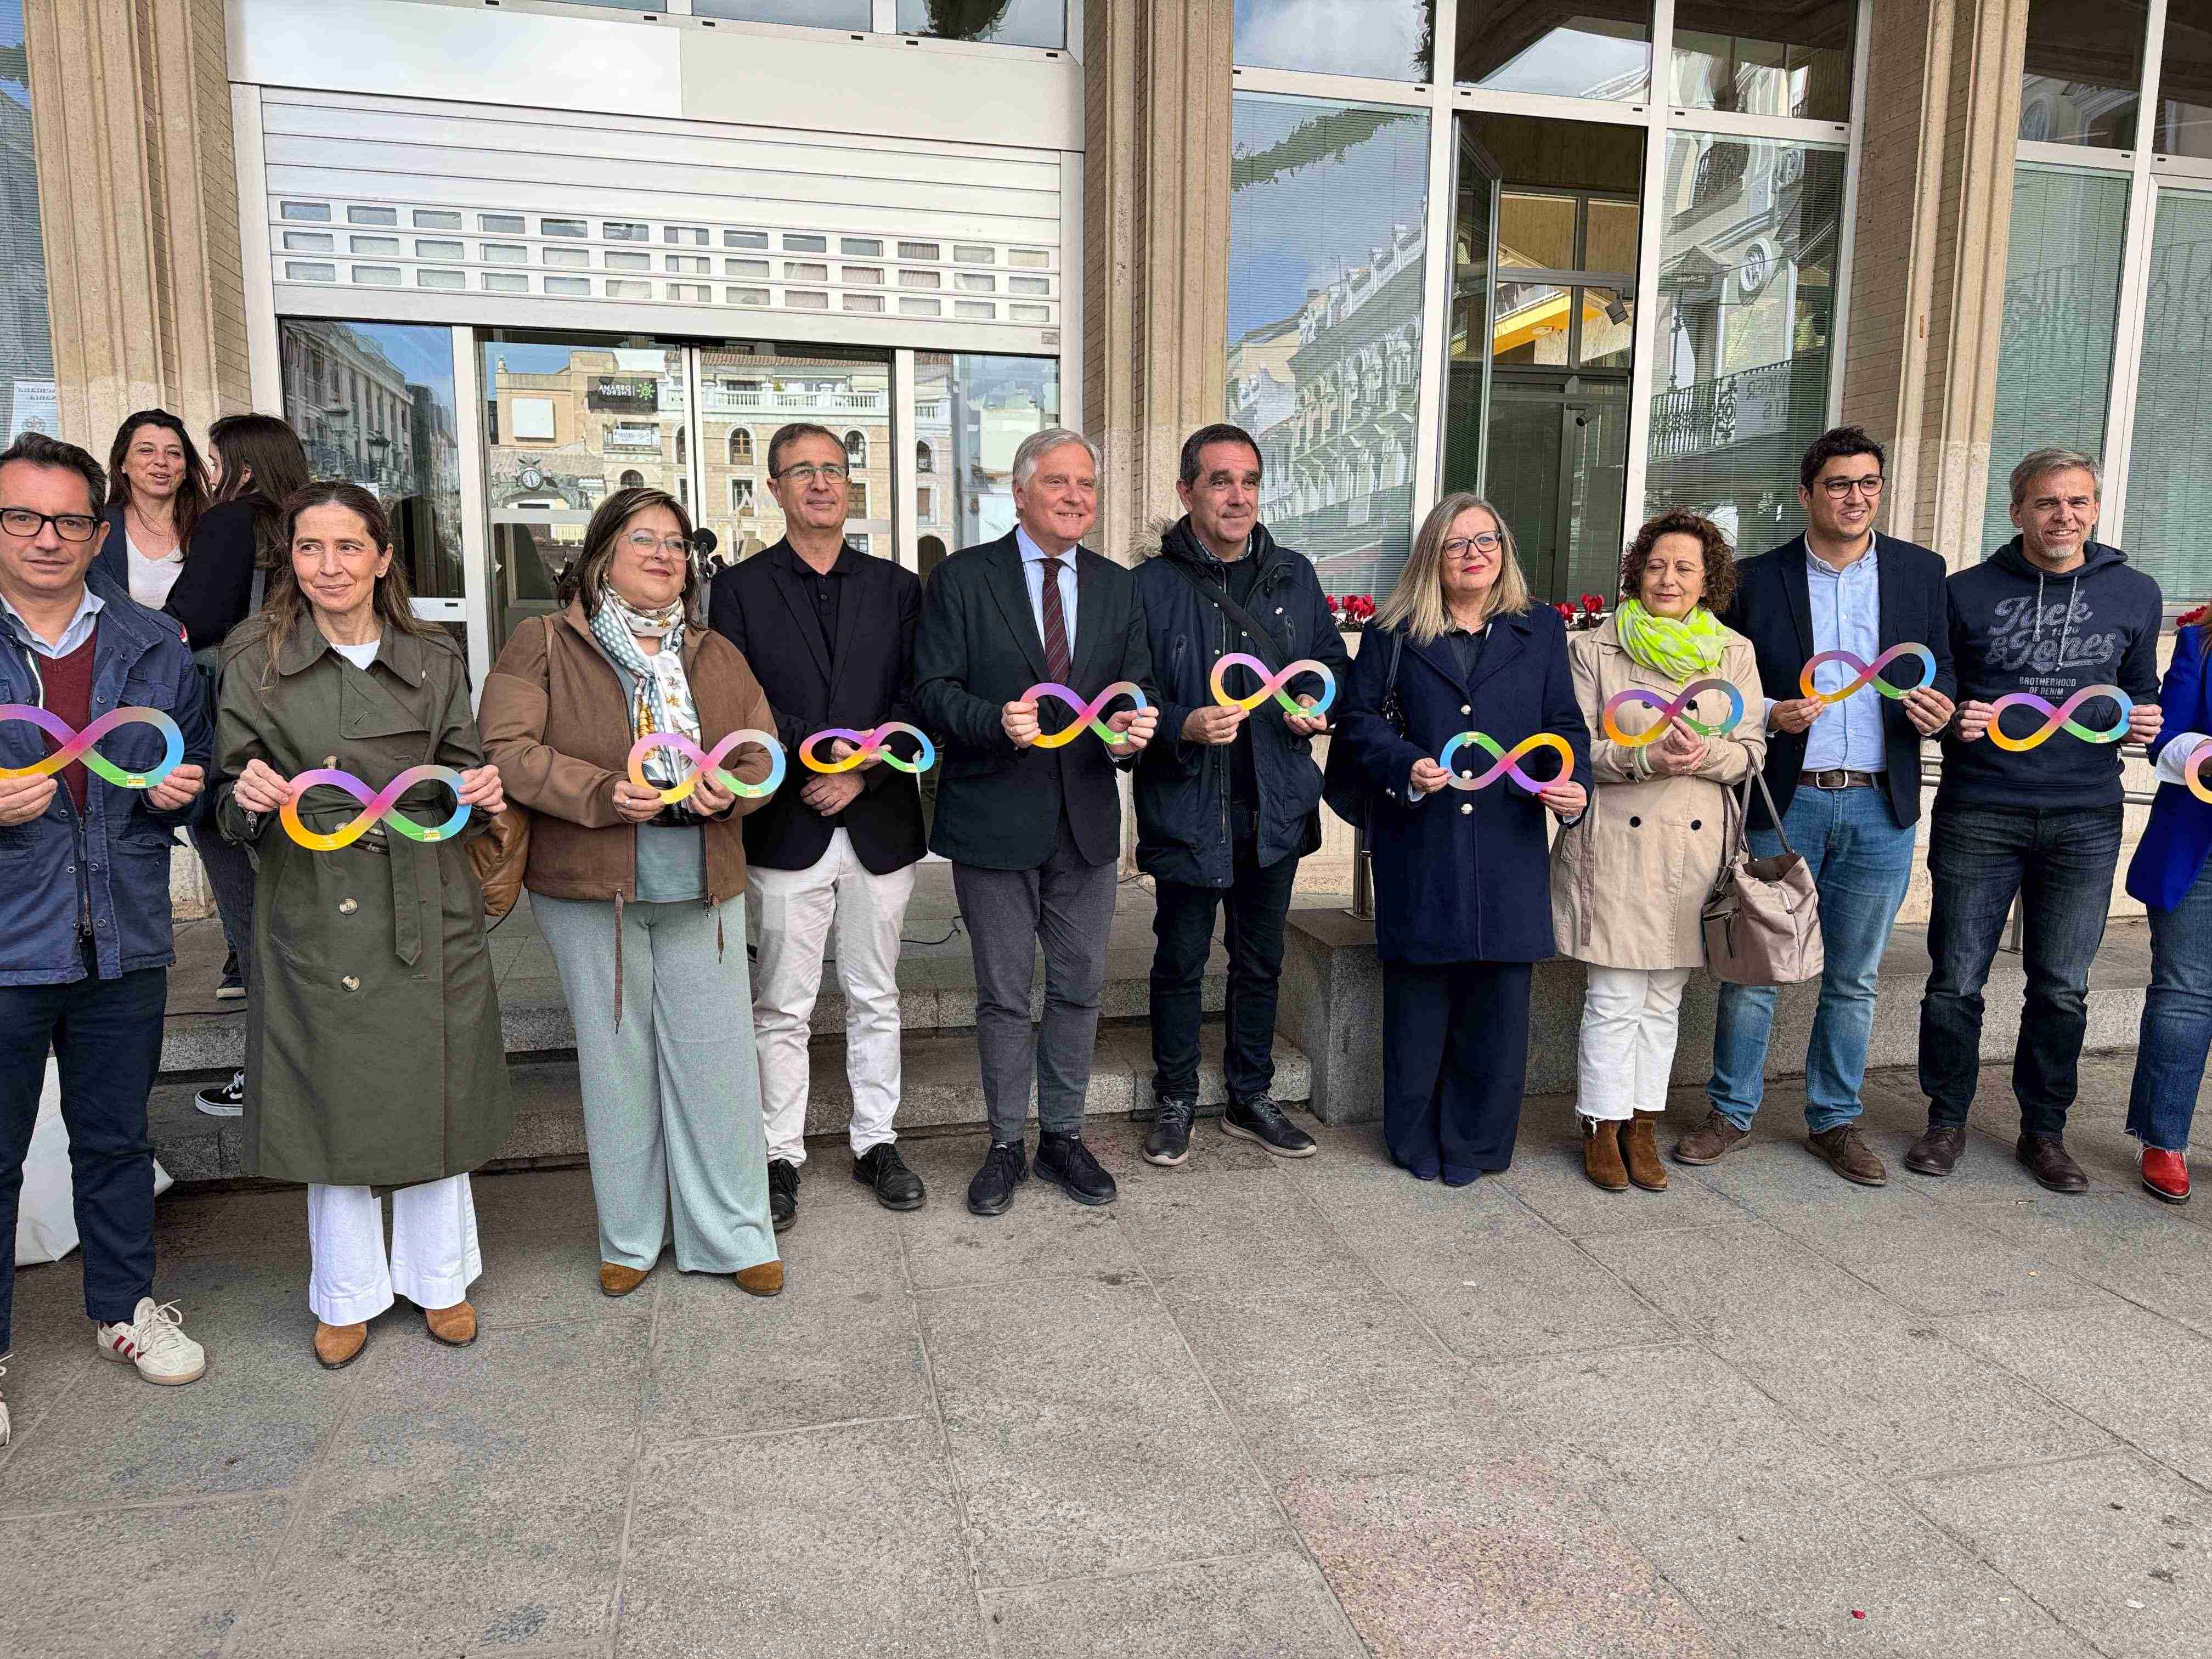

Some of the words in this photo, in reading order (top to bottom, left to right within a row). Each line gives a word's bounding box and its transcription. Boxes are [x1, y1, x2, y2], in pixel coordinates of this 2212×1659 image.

[1987, 590, 2094, 636] Jack
[1985, 636, 2008, 664] &
[2001, 629, 2116, 670] Jones
[2019, 676, 2076, 687] BROTHERHOOD
[2040, 687, 2064, 696] DENIM
